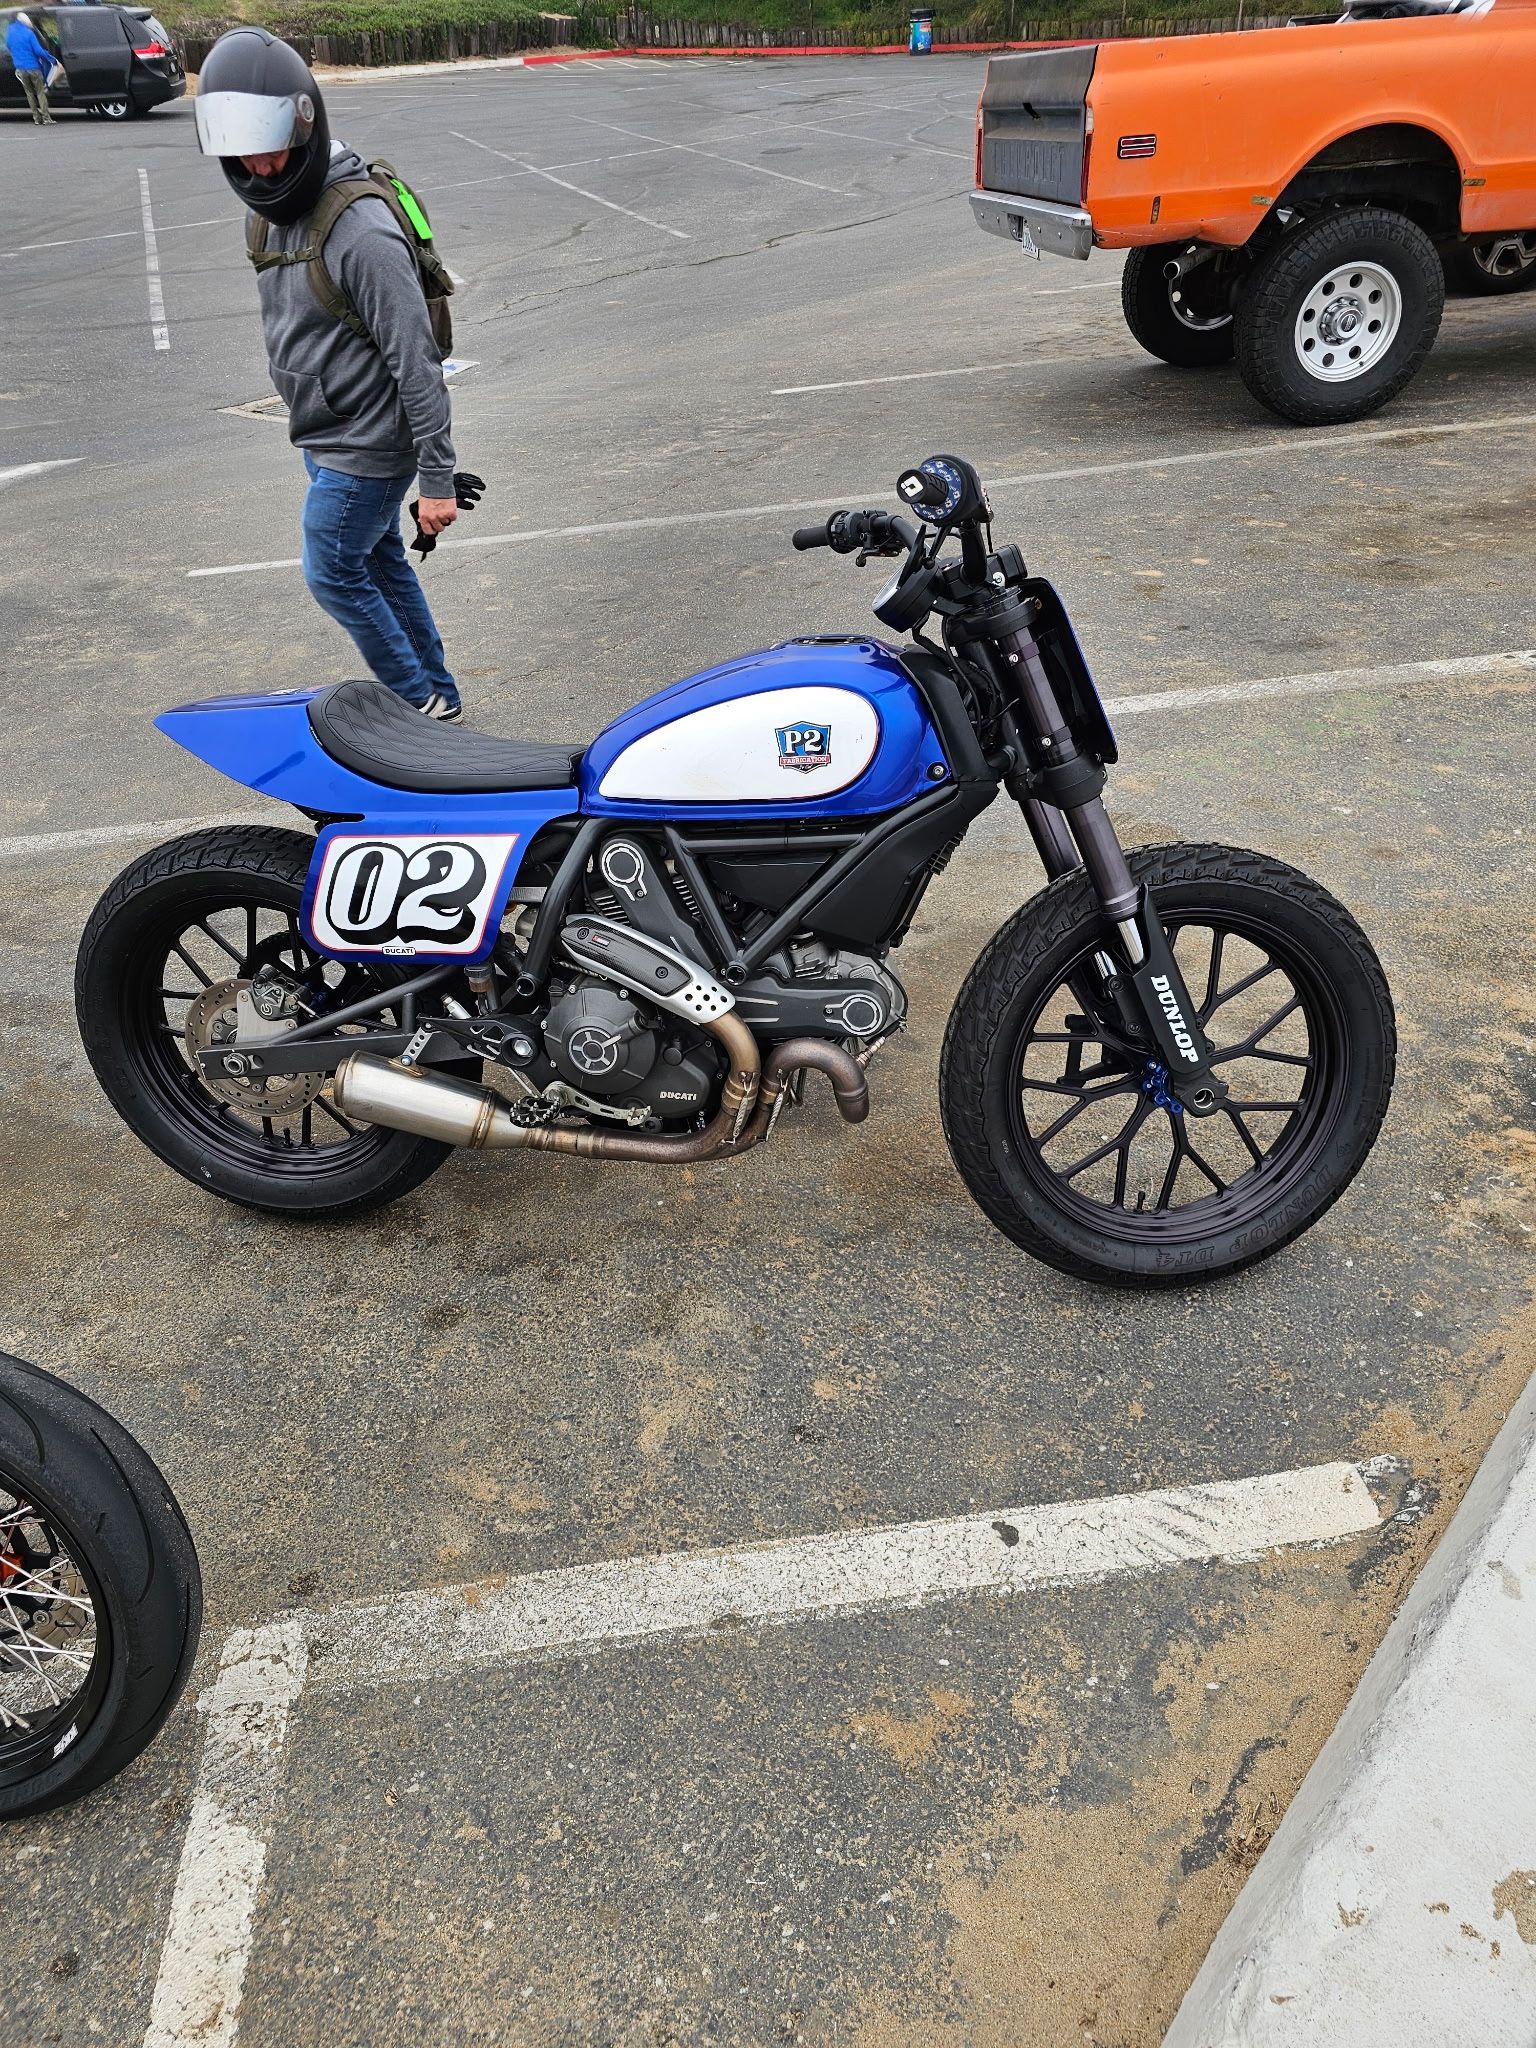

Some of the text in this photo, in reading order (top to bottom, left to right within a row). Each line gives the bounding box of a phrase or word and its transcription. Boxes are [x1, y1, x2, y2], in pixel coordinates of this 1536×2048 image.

[782, 756, 827, 764] FABRICATION
[783, 729, 823, 754] P2
[325, 841, 486, 945] 02
[1150, 974, 1199, 1063] DUNLOP
[659, 1091, 697, 1101] DUCATI
[1155, 1164, 1333, 1268] DUNLOP DT4
